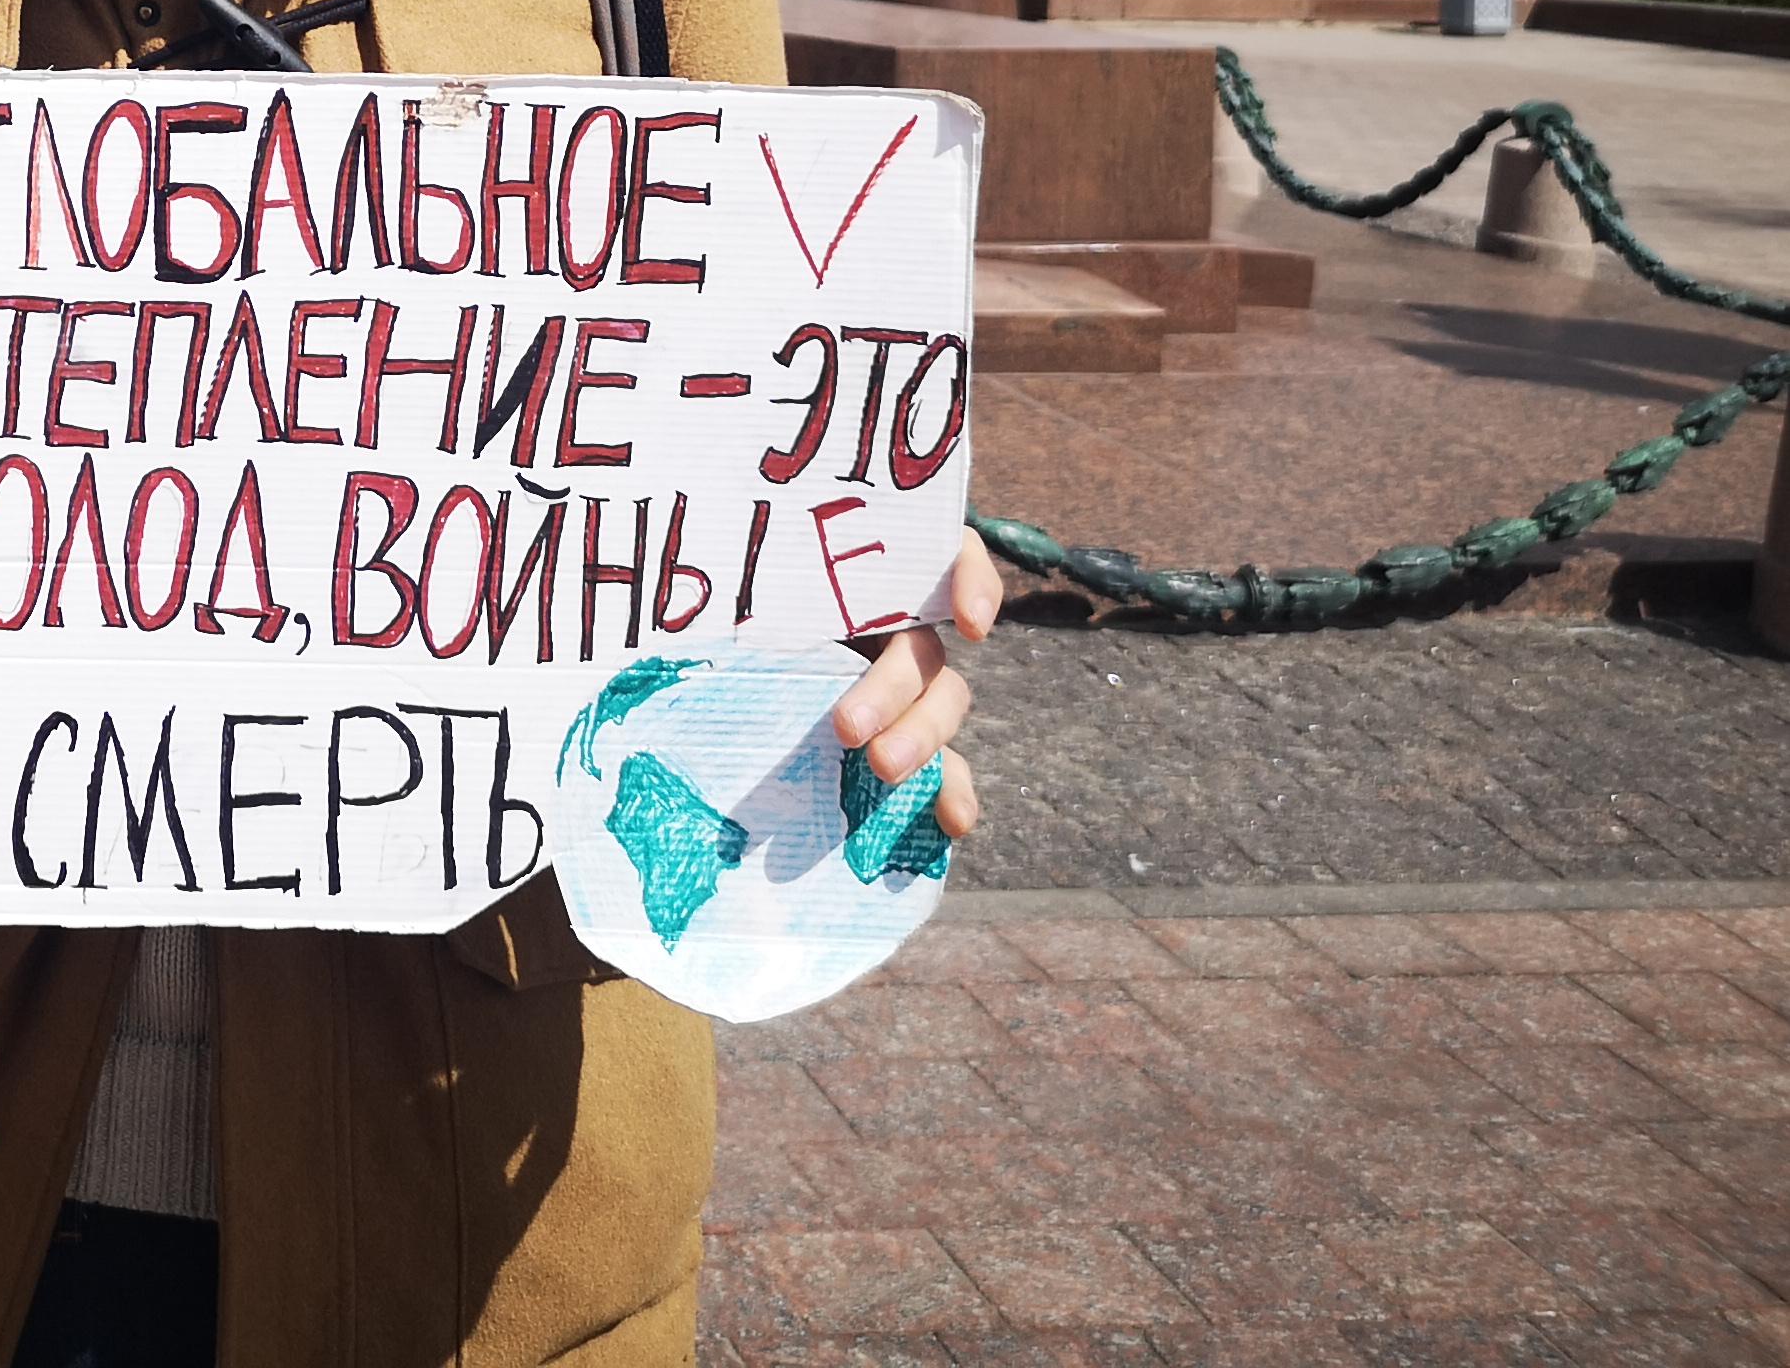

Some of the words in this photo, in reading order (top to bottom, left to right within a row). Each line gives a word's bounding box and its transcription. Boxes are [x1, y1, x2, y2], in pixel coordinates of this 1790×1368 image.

[758, 114, 918, 289] V
[759, 322, 967, 491] ЭТО
[331, 470, 771, 665] ВОЙНЫ
[11, 702, 545, 898] СМЕРТЬ
